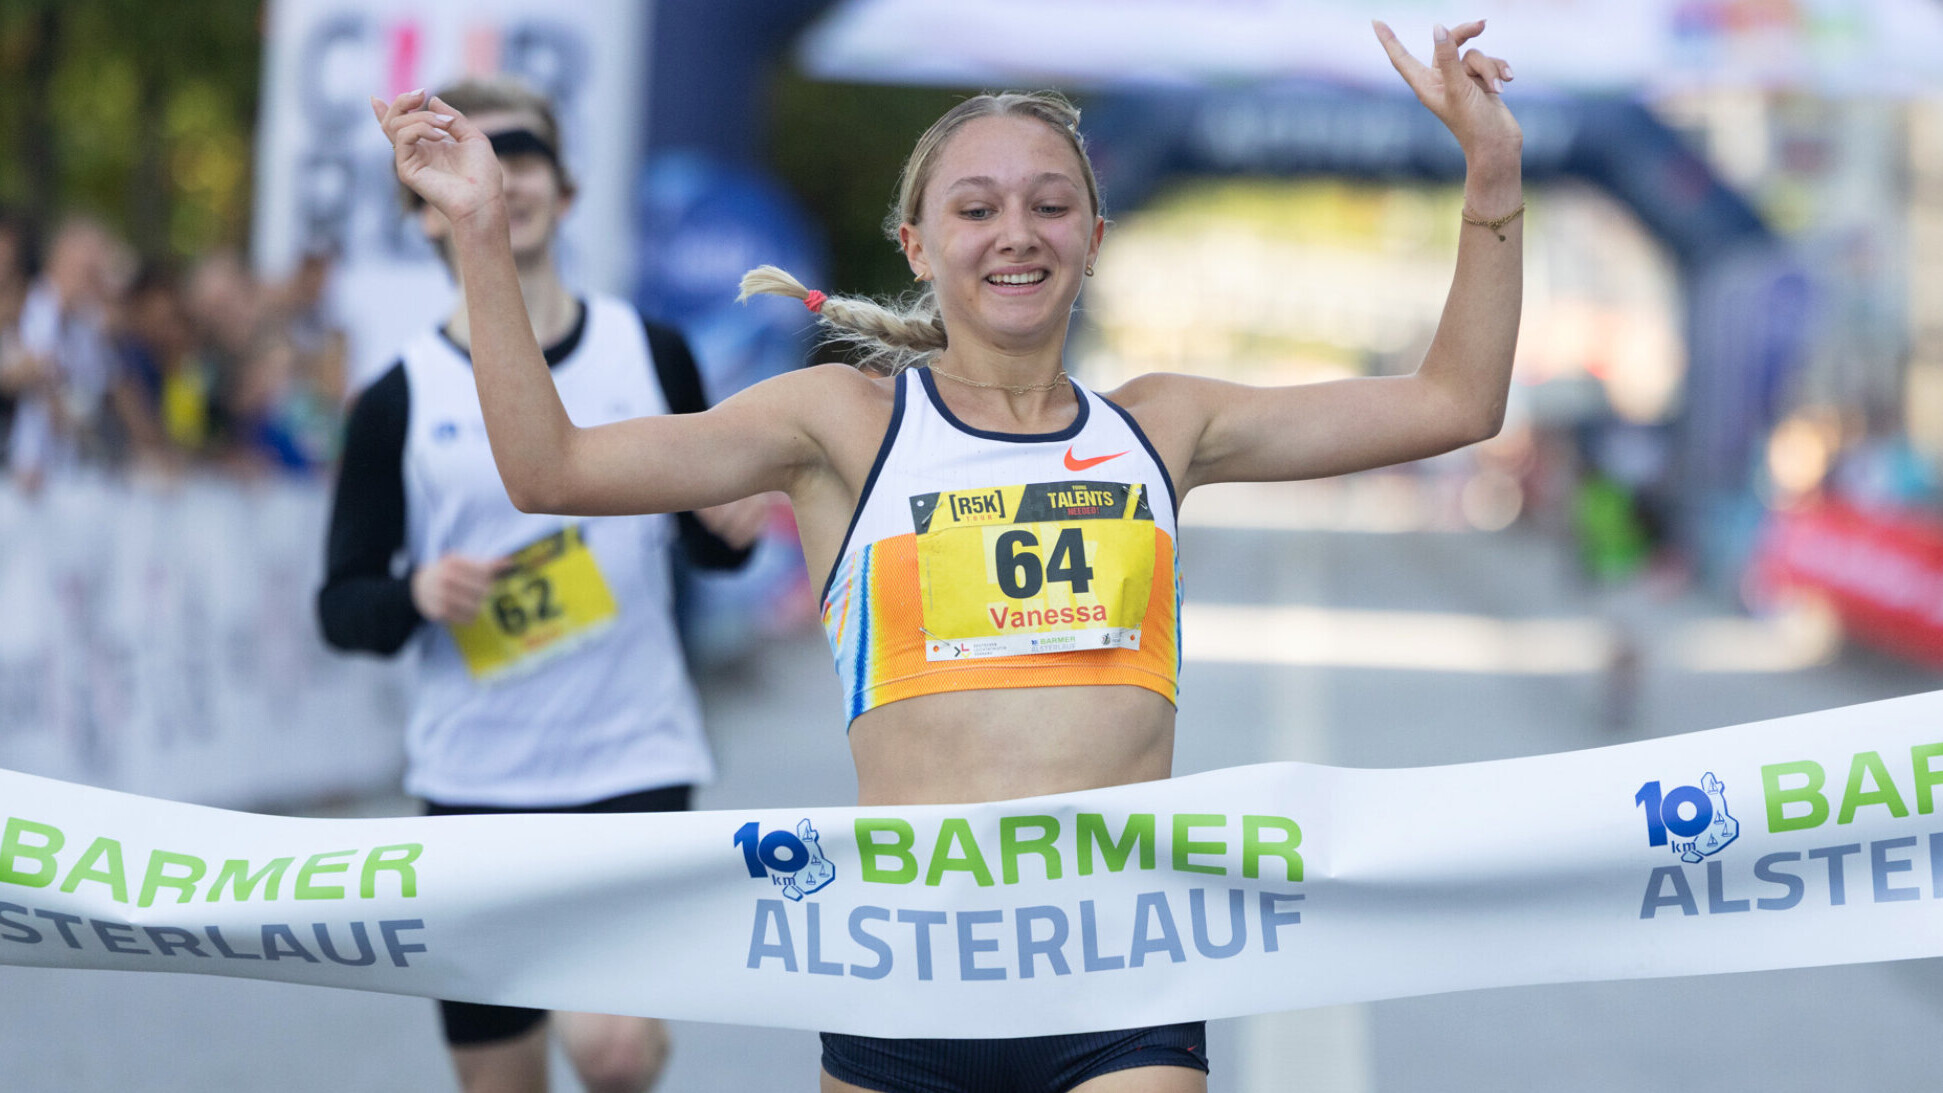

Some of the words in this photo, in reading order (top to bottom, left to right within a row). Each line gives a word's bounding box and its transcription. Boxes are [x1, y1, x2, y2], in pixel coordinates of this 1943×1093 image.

[1047, 490, 1114, 508] TALENTS
[995, 527, 1094, 599] 64
[492, 577, 564, 636] 62
[990, 604, 1108, 629] Vanessa
[1040, 635, 1076, 644] BARMER
[1634, 780, 1713, 847] 10
[0, 816, 424, 908] BARMER
[733, 822, 810, 878] 10
[854, 813, 1305, 888] BARMER
[1639, 832, 1943, 919] ALSTE
[1671, 840, 1697, 853] km
[771, 873, 797, 886] km
[0, 903, 428, 967] STERLAUF
[746, 888, 1306, 981] ALSTERLAUF
